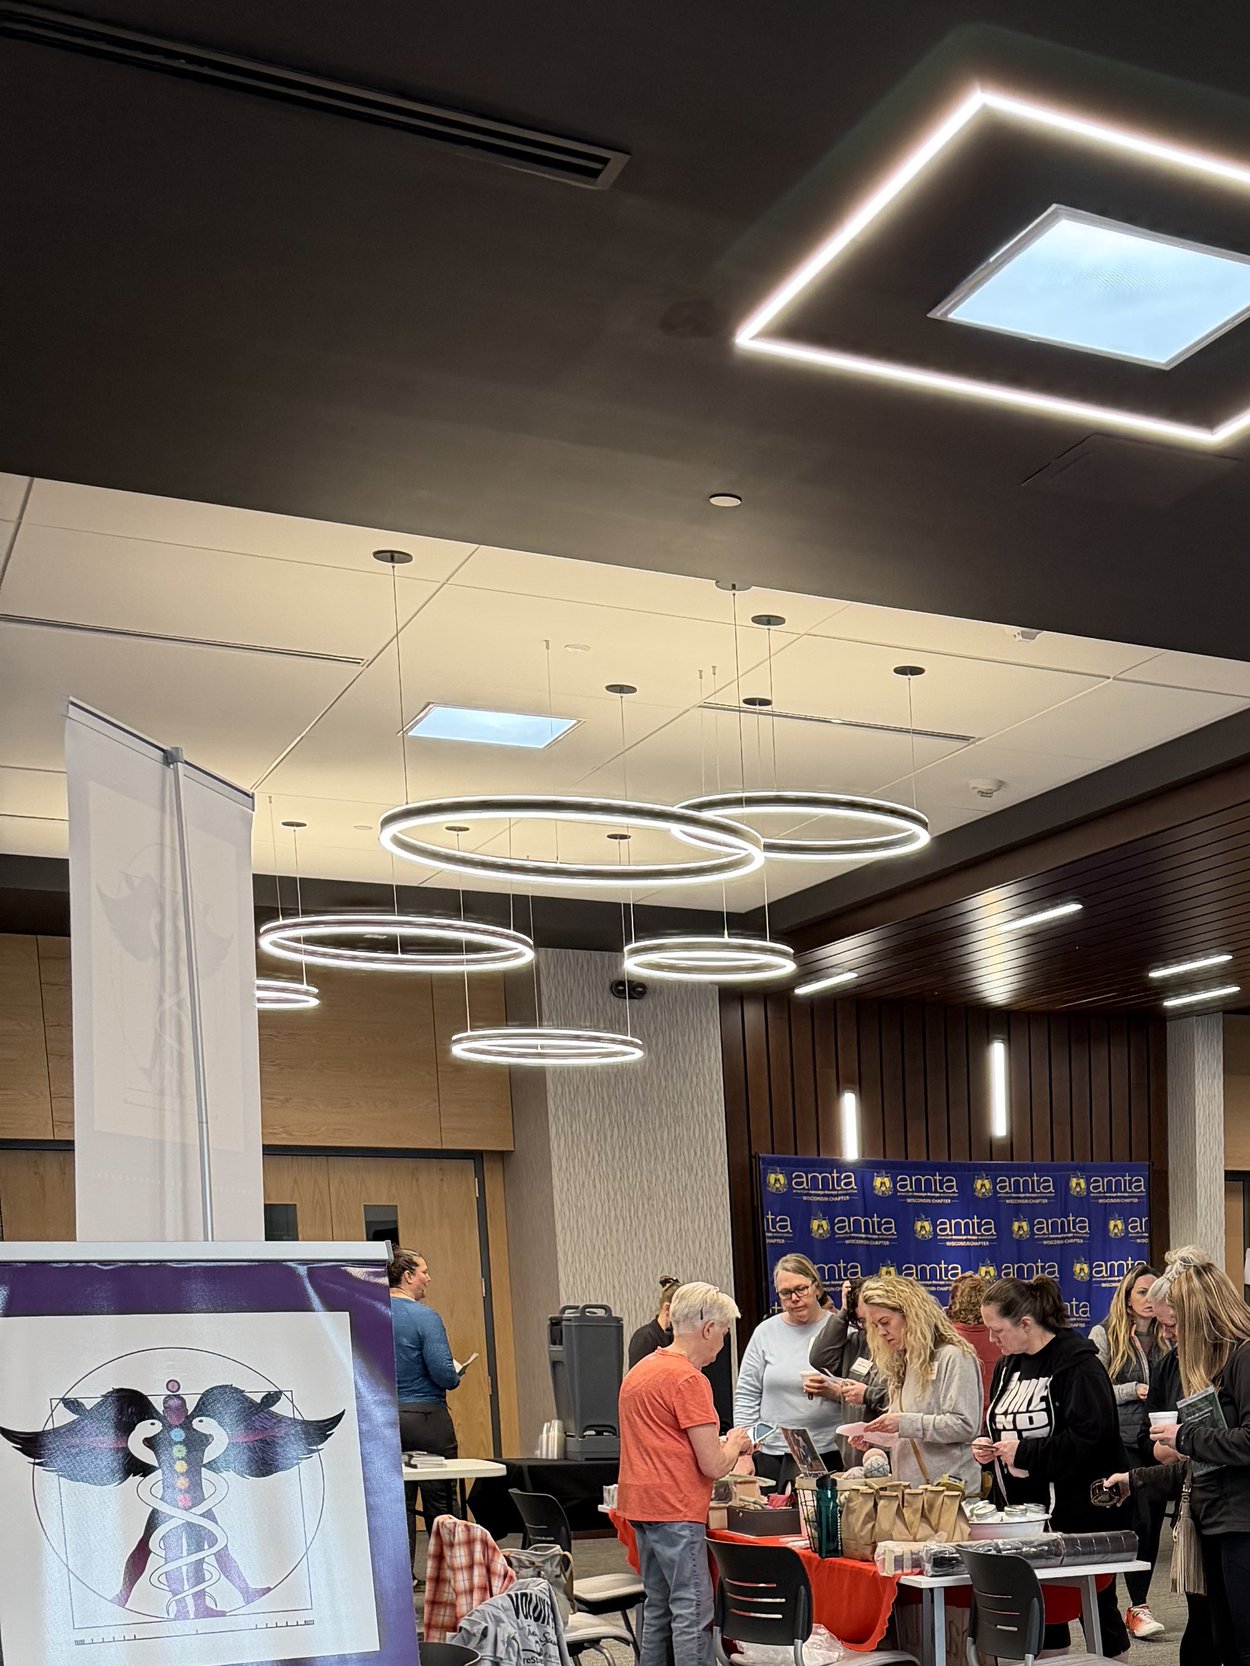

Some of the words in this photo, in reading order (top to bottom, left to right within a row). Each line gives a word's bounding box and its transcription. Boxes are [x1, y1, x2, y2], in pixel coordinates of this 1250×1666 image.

[791, 1168, 857, 1190] amta
[896, 1171, 958, 1193] amta
[996, 1172, 1055, 1193] amta
[1089, 1172, 1146, 1193] amta
[834, 1213, 897, 1235] amta
[936, 1214, 997, 1235] amta
[1033, 1212, 1090, 1235] amta
[815, 1259, 863, 1280] mta
[902, 1259, 962, 1280] amta
[1001, 1258, 1060, 1279] amta
